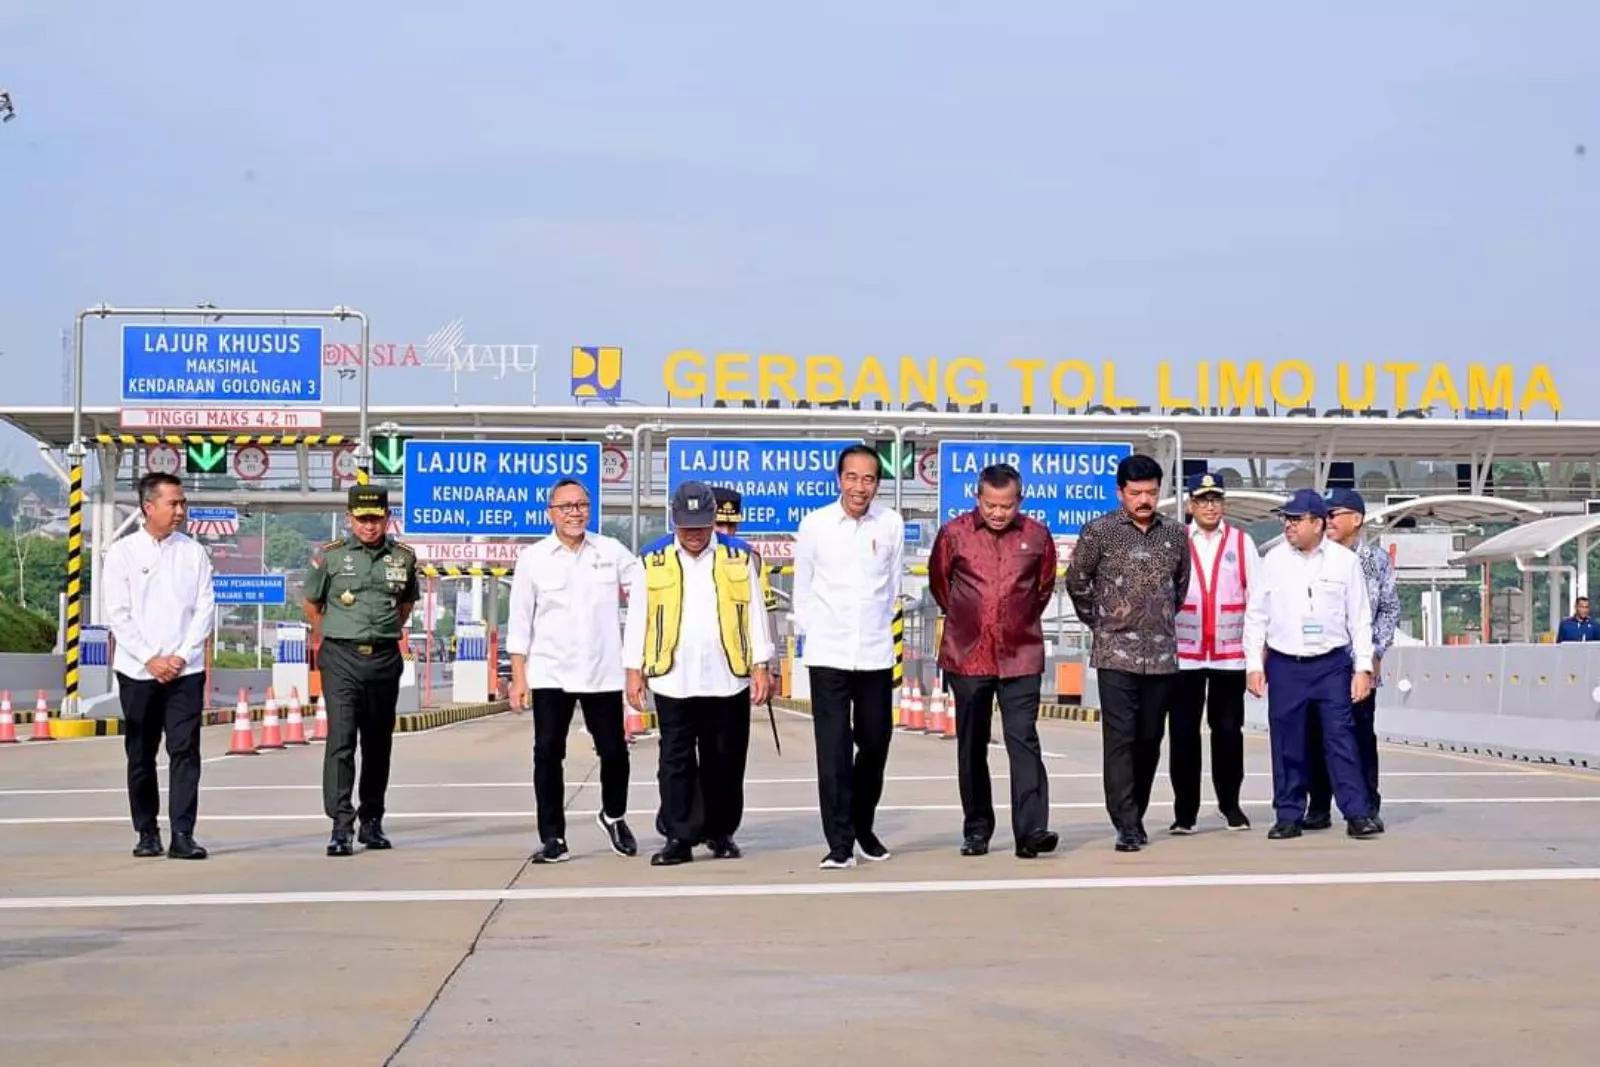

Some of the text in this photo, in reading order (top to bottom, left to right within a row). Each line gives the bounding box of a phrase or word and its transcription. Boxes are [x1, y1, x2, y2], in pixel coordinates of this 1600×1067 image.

[144, 333, 300, 353] LAJUR KHUSUS
[186, 358, 259, 374] MAKSIMAL
[129, 378, 315, 394] KENDARAAN GOLONGAN 3
[663, 349, 1564, 413] GERBANG TOL LIMO UTAMA
[146, 411, 297, 427] TINGGI MAKS 4.2 m
[417, 452, 588, 475] LAJUR KHUSUS
[680, 450, 842, 472] LAJUR KHUSU
[1031, 453, 1119, 475] KHUSUS
[433, 486, 528, 502] KENDARAAN
[796, 481, 837, 496] KECIL
[1065, 484, 1107, 500] KECIL
[414, 508, 470, 526] SEDAN,
[477, 509, 517, 527] JEEP,
[426, 544, 478, 558] TINGGI
